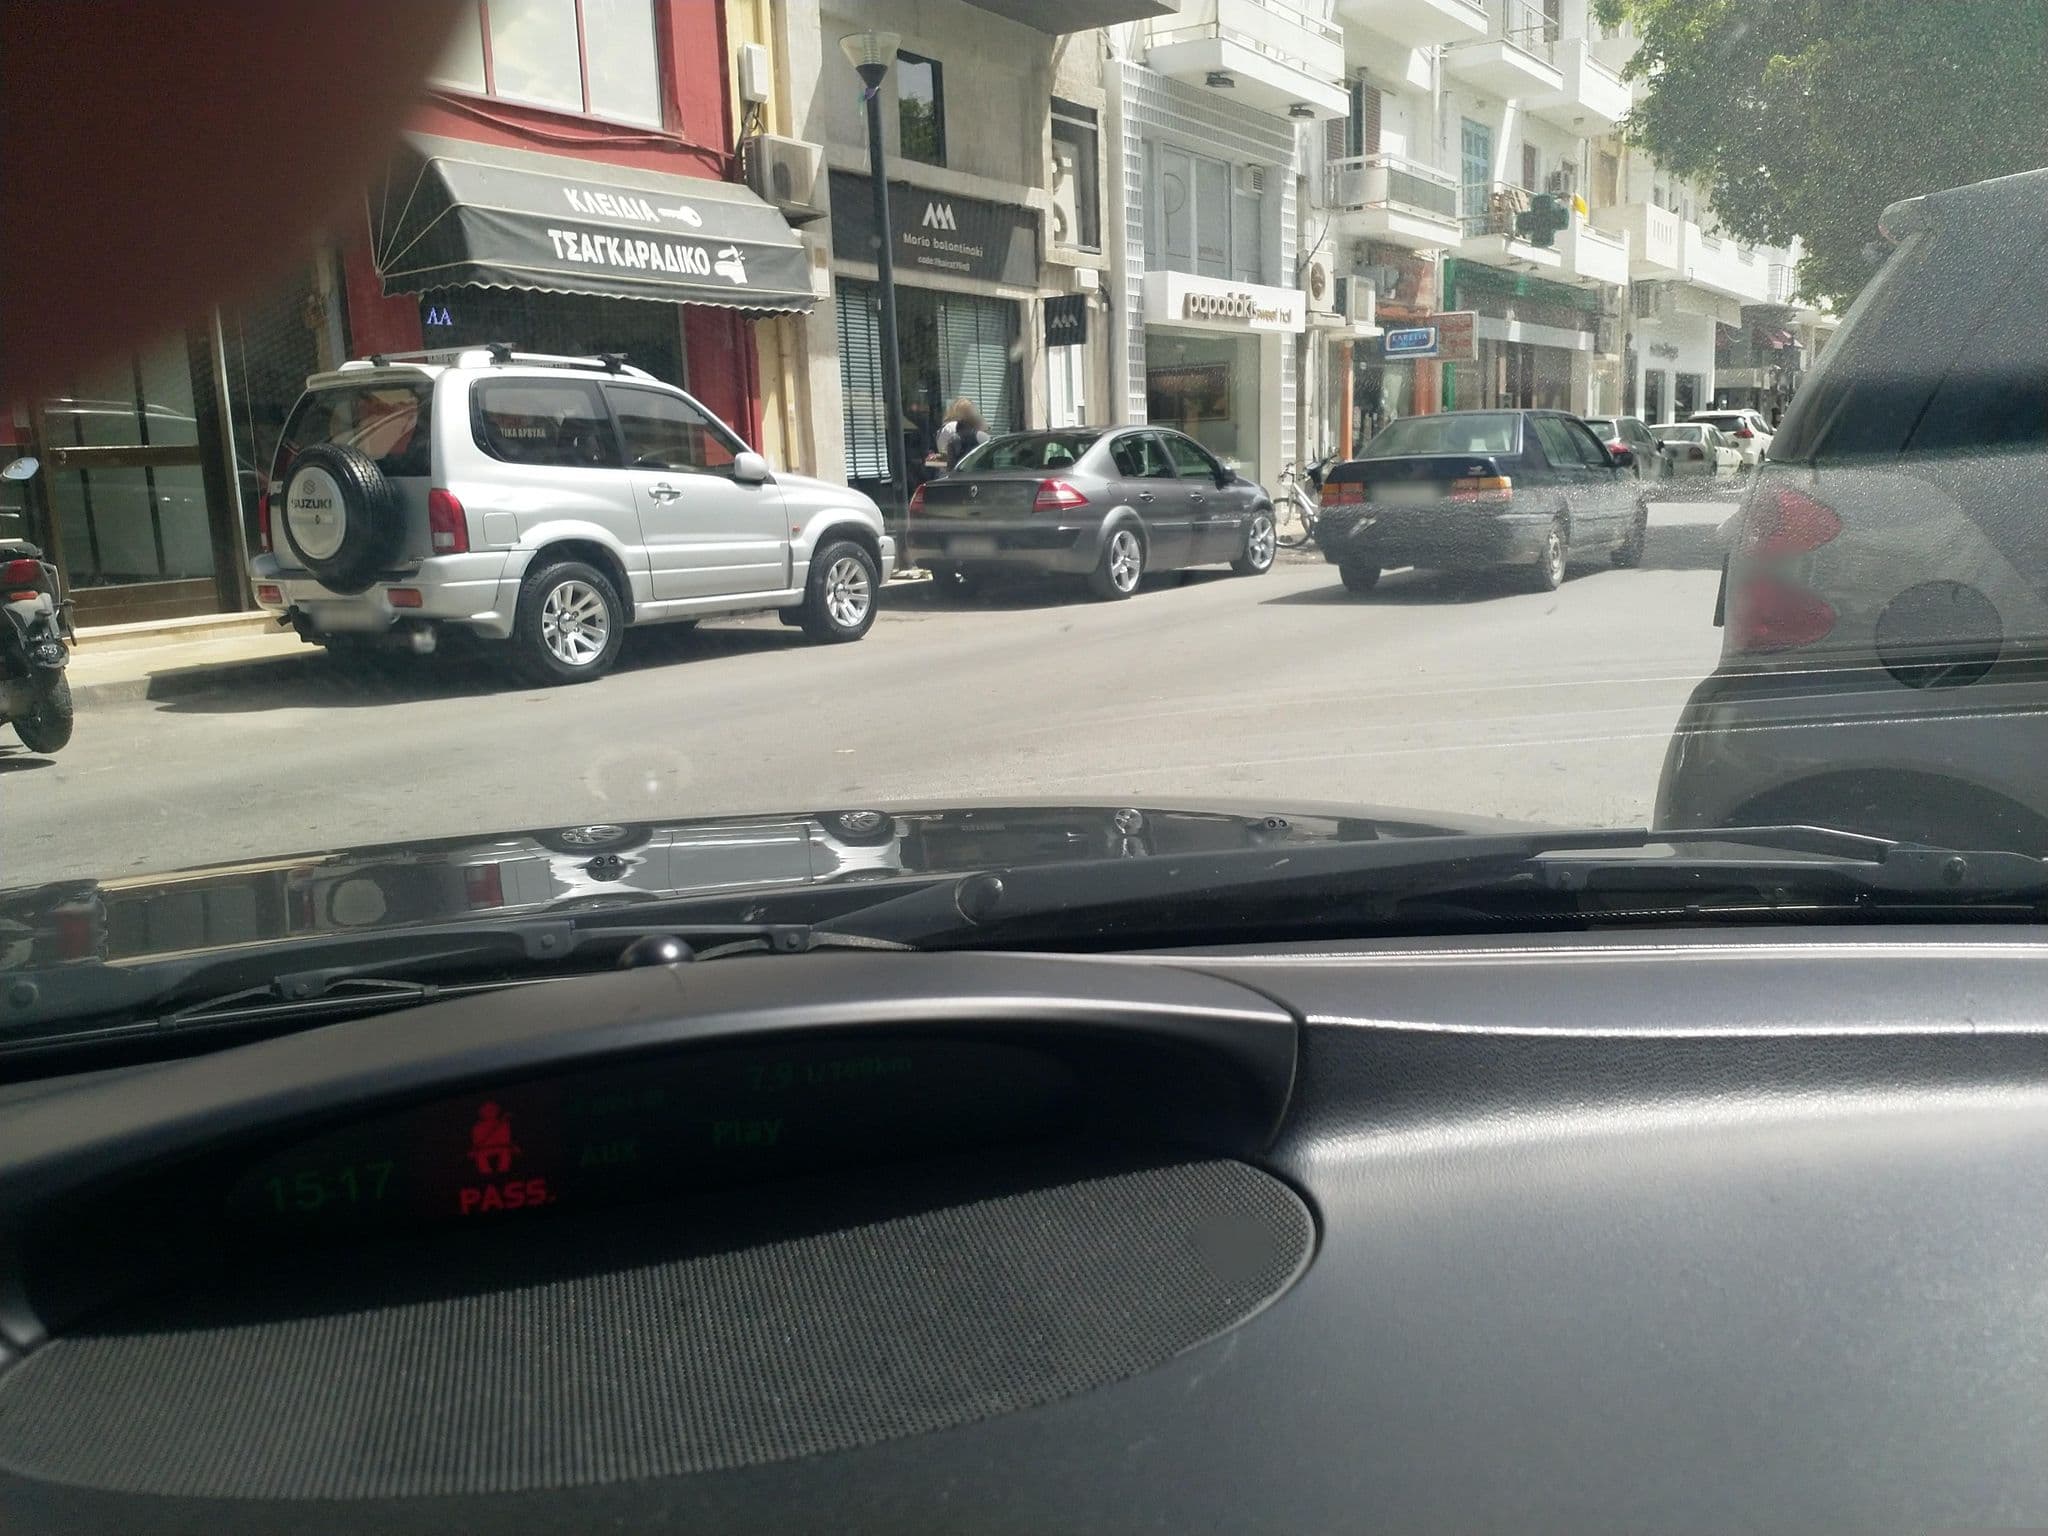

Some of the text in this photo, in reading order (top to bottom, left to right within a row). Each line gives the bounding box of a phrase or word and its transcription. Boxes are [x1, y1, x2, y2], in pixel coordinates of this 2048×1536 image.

[563, 187, 661, 223] ΚΛΕΙΔΙΑ
[547, 228, 711, 276] ΤΣΑΓΚΑΡΑΔΙΚΟ
[291, 498, 332, 509] SUZUKI
